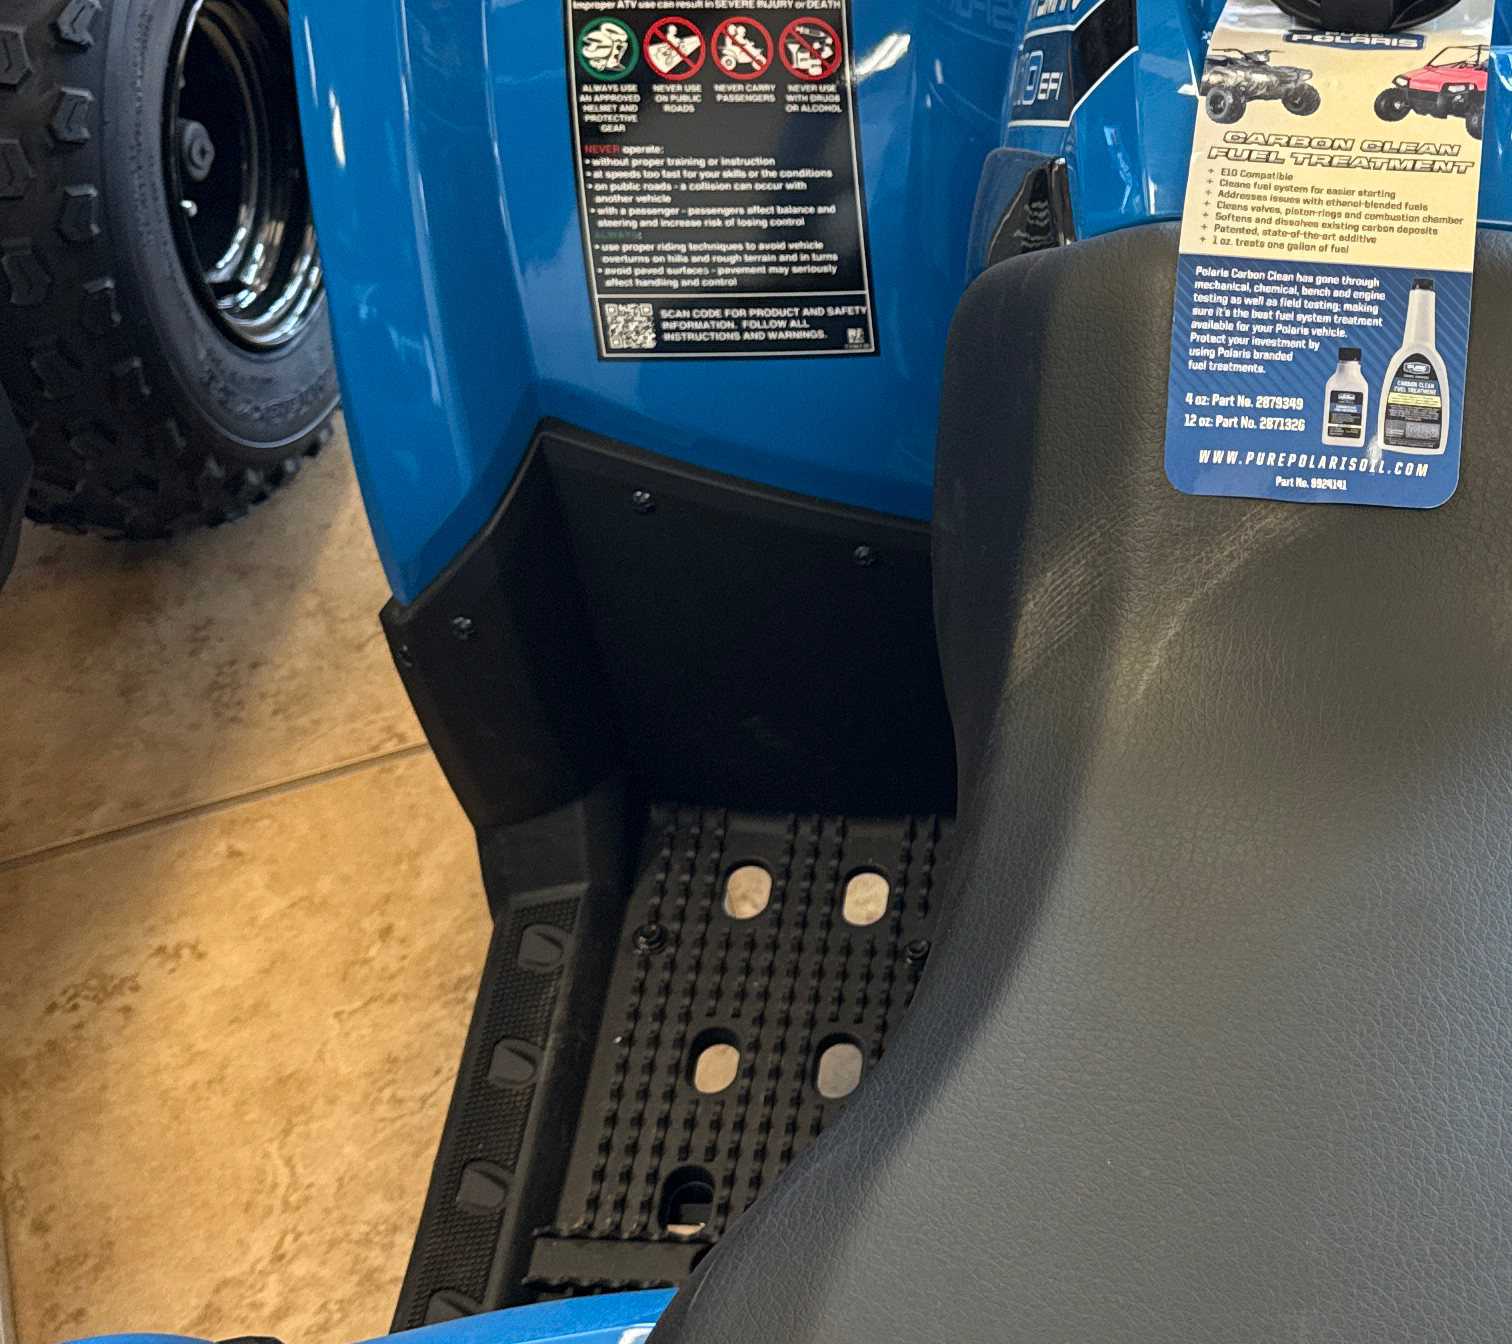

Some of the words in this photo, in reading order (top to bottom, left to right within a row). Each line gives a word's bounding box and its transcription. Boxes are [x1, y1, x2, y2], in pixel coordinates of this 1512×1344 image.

[1291, 34, 1419, 49] POLARIS
[1038, 72, 1064, 101] EFI
[584, 145, 621, 154] NEVER
[622, 145, 665, 156] operate:
[1223, 131, 1355, 151] CARBON
[1360, 139, 1461, 157] CLEAN
[592, 157, 630, 166] without
[631, 158, 665, 168] proper
[666, 157, 706, 168] training
[721, 157, 775, 166] instruction
[1207, 146, 1285, 164] FUEL
[1290, 151, 1475, 175] TREATMENT
[1221, 168, 1238, 178] E10
[1240, 169, 1294, 181] Compatible
[1219, 179, 1251, 190] Cleans
[1253, 181, 1272, 191] fuel
[1274, 183, 1308, 195] system
[1310, 185, 1323, 195] for
[1326, 187, 1356, 197] easier
[1358, 188, 1396, 200] starting
[660, 309, 691, 319] SCAN
[692, 309, 723, 318] CODE
[724, 308, 747, 318] FOR
[749, 308, 800, 318] PRODUCT
[802, 307, 825, 317] AND
[827, 306, 867, 316] SAFETY
[742, 320, 787, 329] FOLLOW
[789, 319, 810, 328] ALL
[743, 331, 766, 340] AND
[1185, 393, 1193, 404] 4
[1195, 395, 1210, 406] oz:
[1212, 395, 1236, 407] Part
[1237, 397, 1254, 408] No.
[1255, 397, 1304, 410] 2879349
[1184, 414, 1196, 427] 12
[1198, 416, 1214, 427] oz:
[1215, 417, 1239, 429] Part
[1240, 418, 1257, 429] No.
[1259, 419, 1305, 432] 2871326
[1198, 449, 1429, 477] WWW.PUREPOLARISOIL.COM
